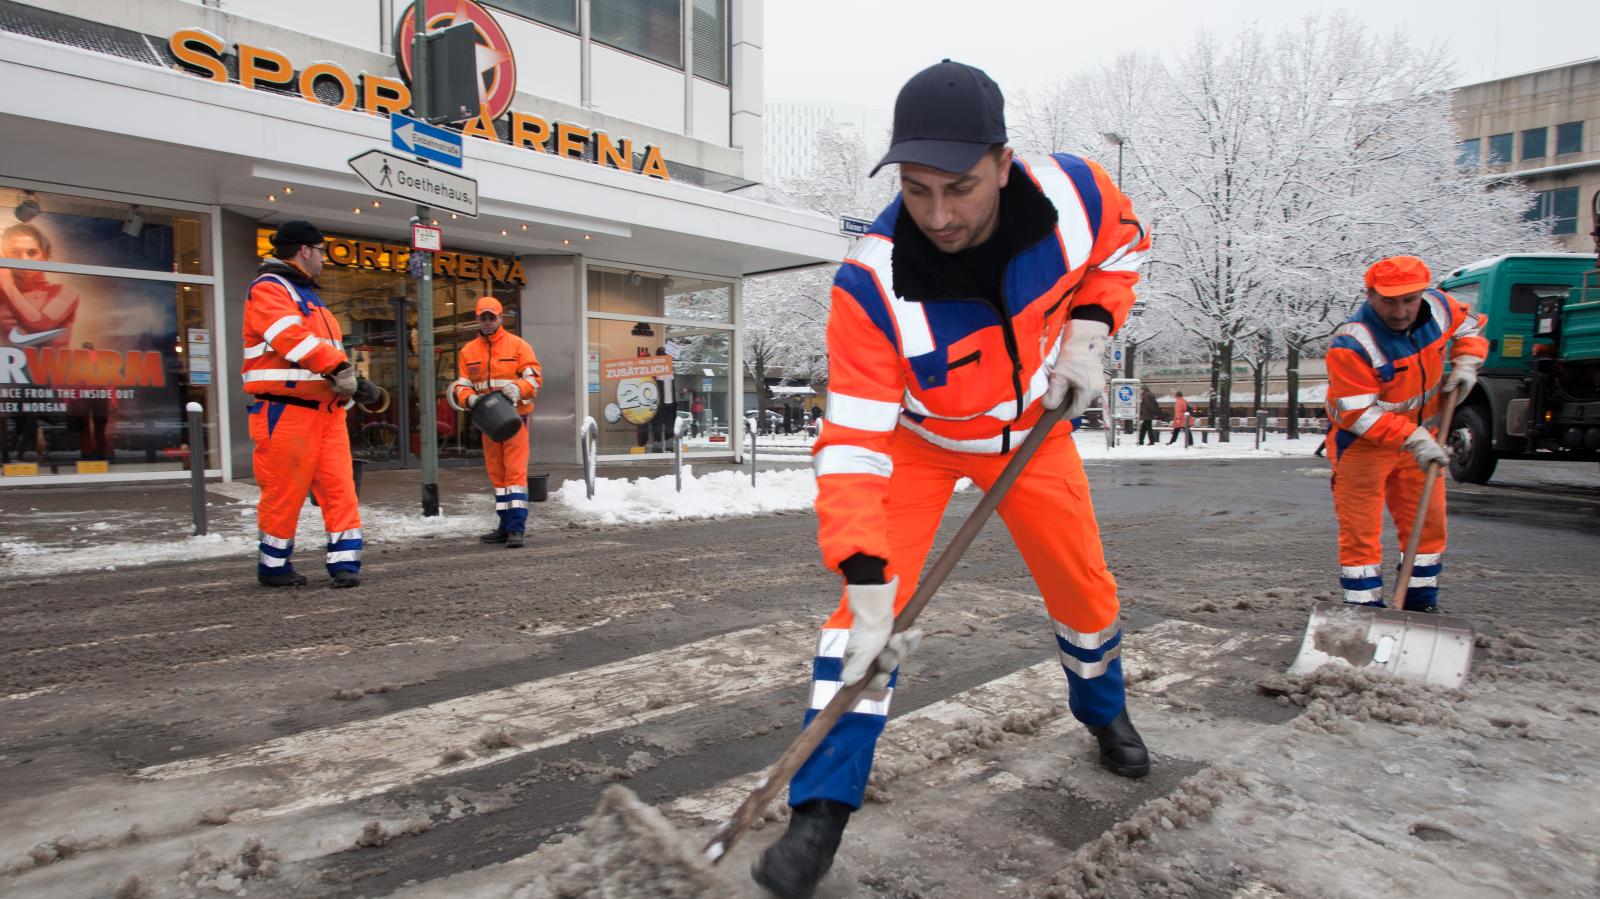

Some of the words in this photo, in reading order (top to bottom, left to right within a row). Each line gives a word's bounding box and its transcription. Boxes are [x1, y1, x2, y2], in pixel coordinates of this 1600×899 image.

[169, 27, 413, 118] SPOR
[412, 132, 459, 156] Einbahnstraße
[397, 170, 469, 203] Goethehaus
[605, 364, 669, 378] ZUSÄTZLICH
[25, 388, 54, 399] FROM
[57, 388, 76, 399] THE
[79, 389, 113, 399] INSIDE
[115, 389, 135, 399] OUT
[22, 402, 67, 413] MORGAN
